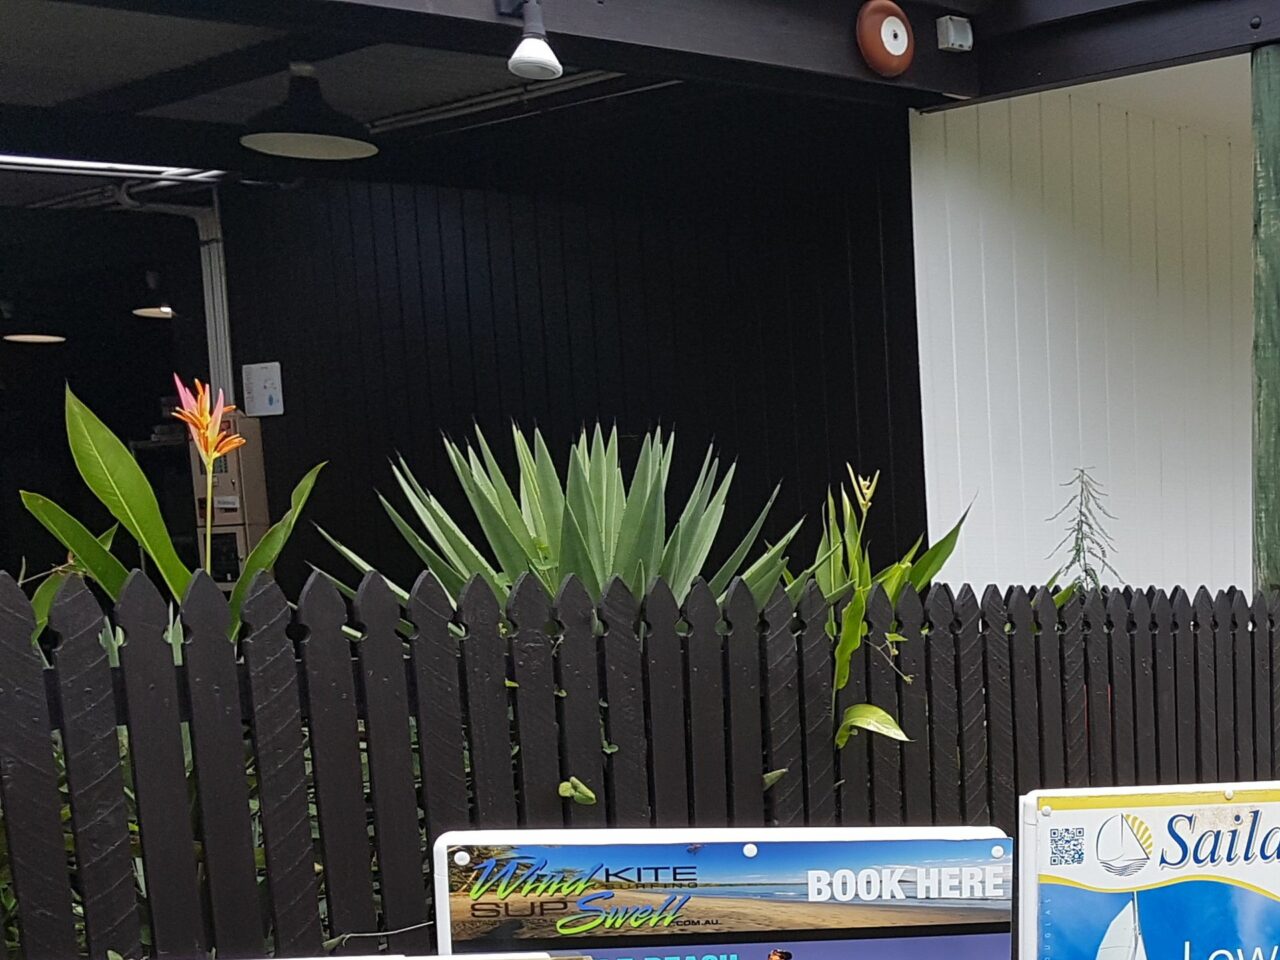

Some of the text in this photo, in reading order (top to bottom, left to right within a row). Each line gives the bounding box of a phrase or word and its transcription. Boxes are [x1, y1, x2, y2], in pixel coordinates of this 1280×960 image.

[469, 856, 697, 900] Wind KITE
[807, 866, 1004, 902] BOOK HERE
[471, 891, 691, 935] SUP Swell
